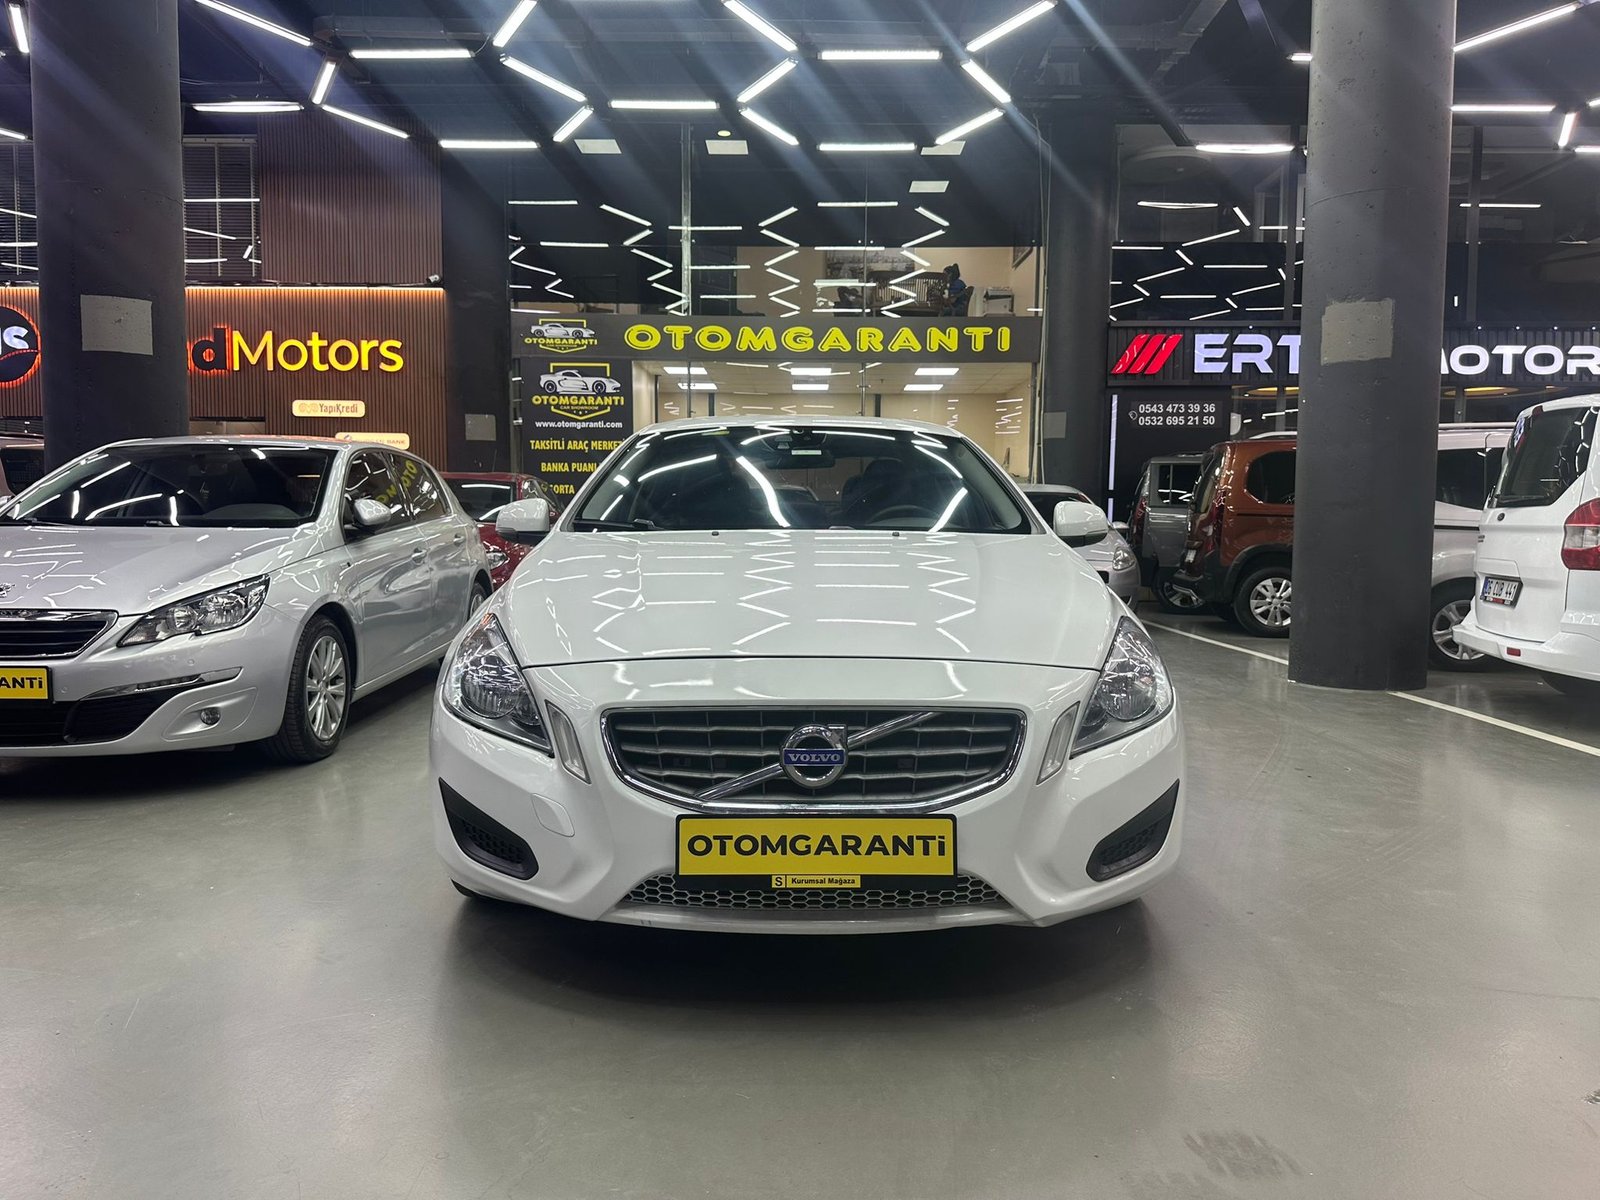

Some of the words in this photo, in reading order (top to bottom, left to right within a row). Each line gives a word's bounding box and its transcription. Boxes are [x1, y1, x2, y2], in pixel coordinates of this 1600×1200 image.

[524, 337, 598, 346] OTOMGARANTI
[623, 323, 1011, 352] OTOMGARANTI
[1440, 344, 1600, 375] OTOR
[532, 395, 625, 406] OTOMGARANTI
[1138, 403, 1164, 413] 0543
[1166, 403, 1185, 413] 473
[1187, 403, 1200, 413] 39
[1202, 403, 1216, 413] 36
[535, 420, 623, 429] www.otomgaranti.com
[1138, 415, 1163, 426] 0532
[1166, 415, 1185, 426] 695
[1187, 415, 1200, 426] 21
[1202, 415, 1216, 426] 50
[530, 437, 565, 450] TAKSİTLİ
[567, 440, 589, 453] ARAÇ
[541, 462, 570, 473] BANKA
[788, 752, 841, 763] VOLVO
[791, 877, 826, 886] Kurumsal
[828, 877, 856, 888] Mağaza
